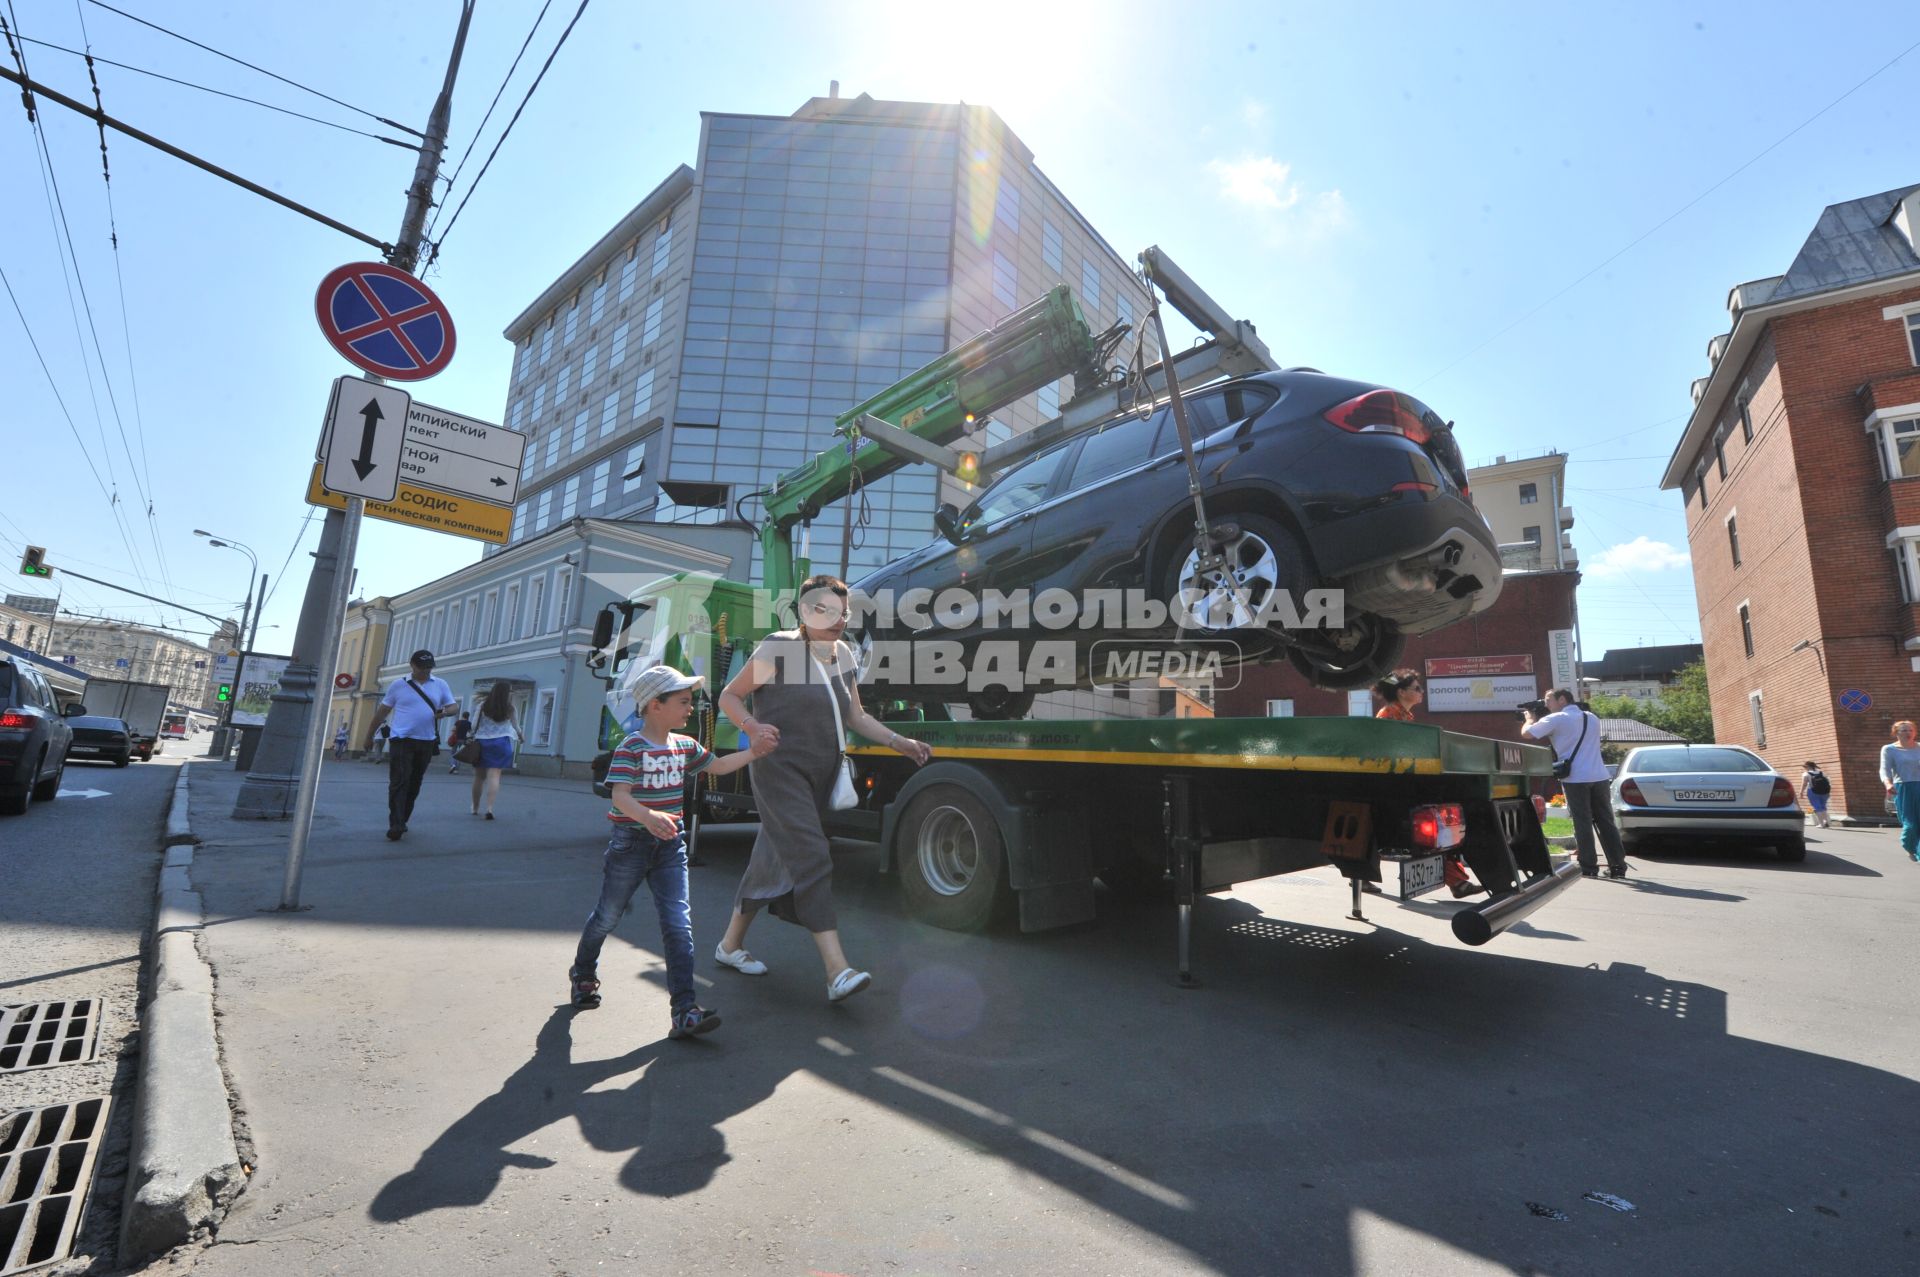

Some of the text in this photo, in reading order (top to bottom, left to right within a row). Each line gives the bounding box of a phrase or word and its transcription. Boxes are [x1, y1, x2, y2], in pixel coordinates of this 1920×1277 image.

[408, 410, 487, 439] МПИЙСКИЙ
[408, 425, 440, 439] пект
[401, 461, 426, 475] вар
[400, 490, 459, 513] СОДИС
[443, 519, 504, 538] компания
[705, 794, 724, 803] MAN
